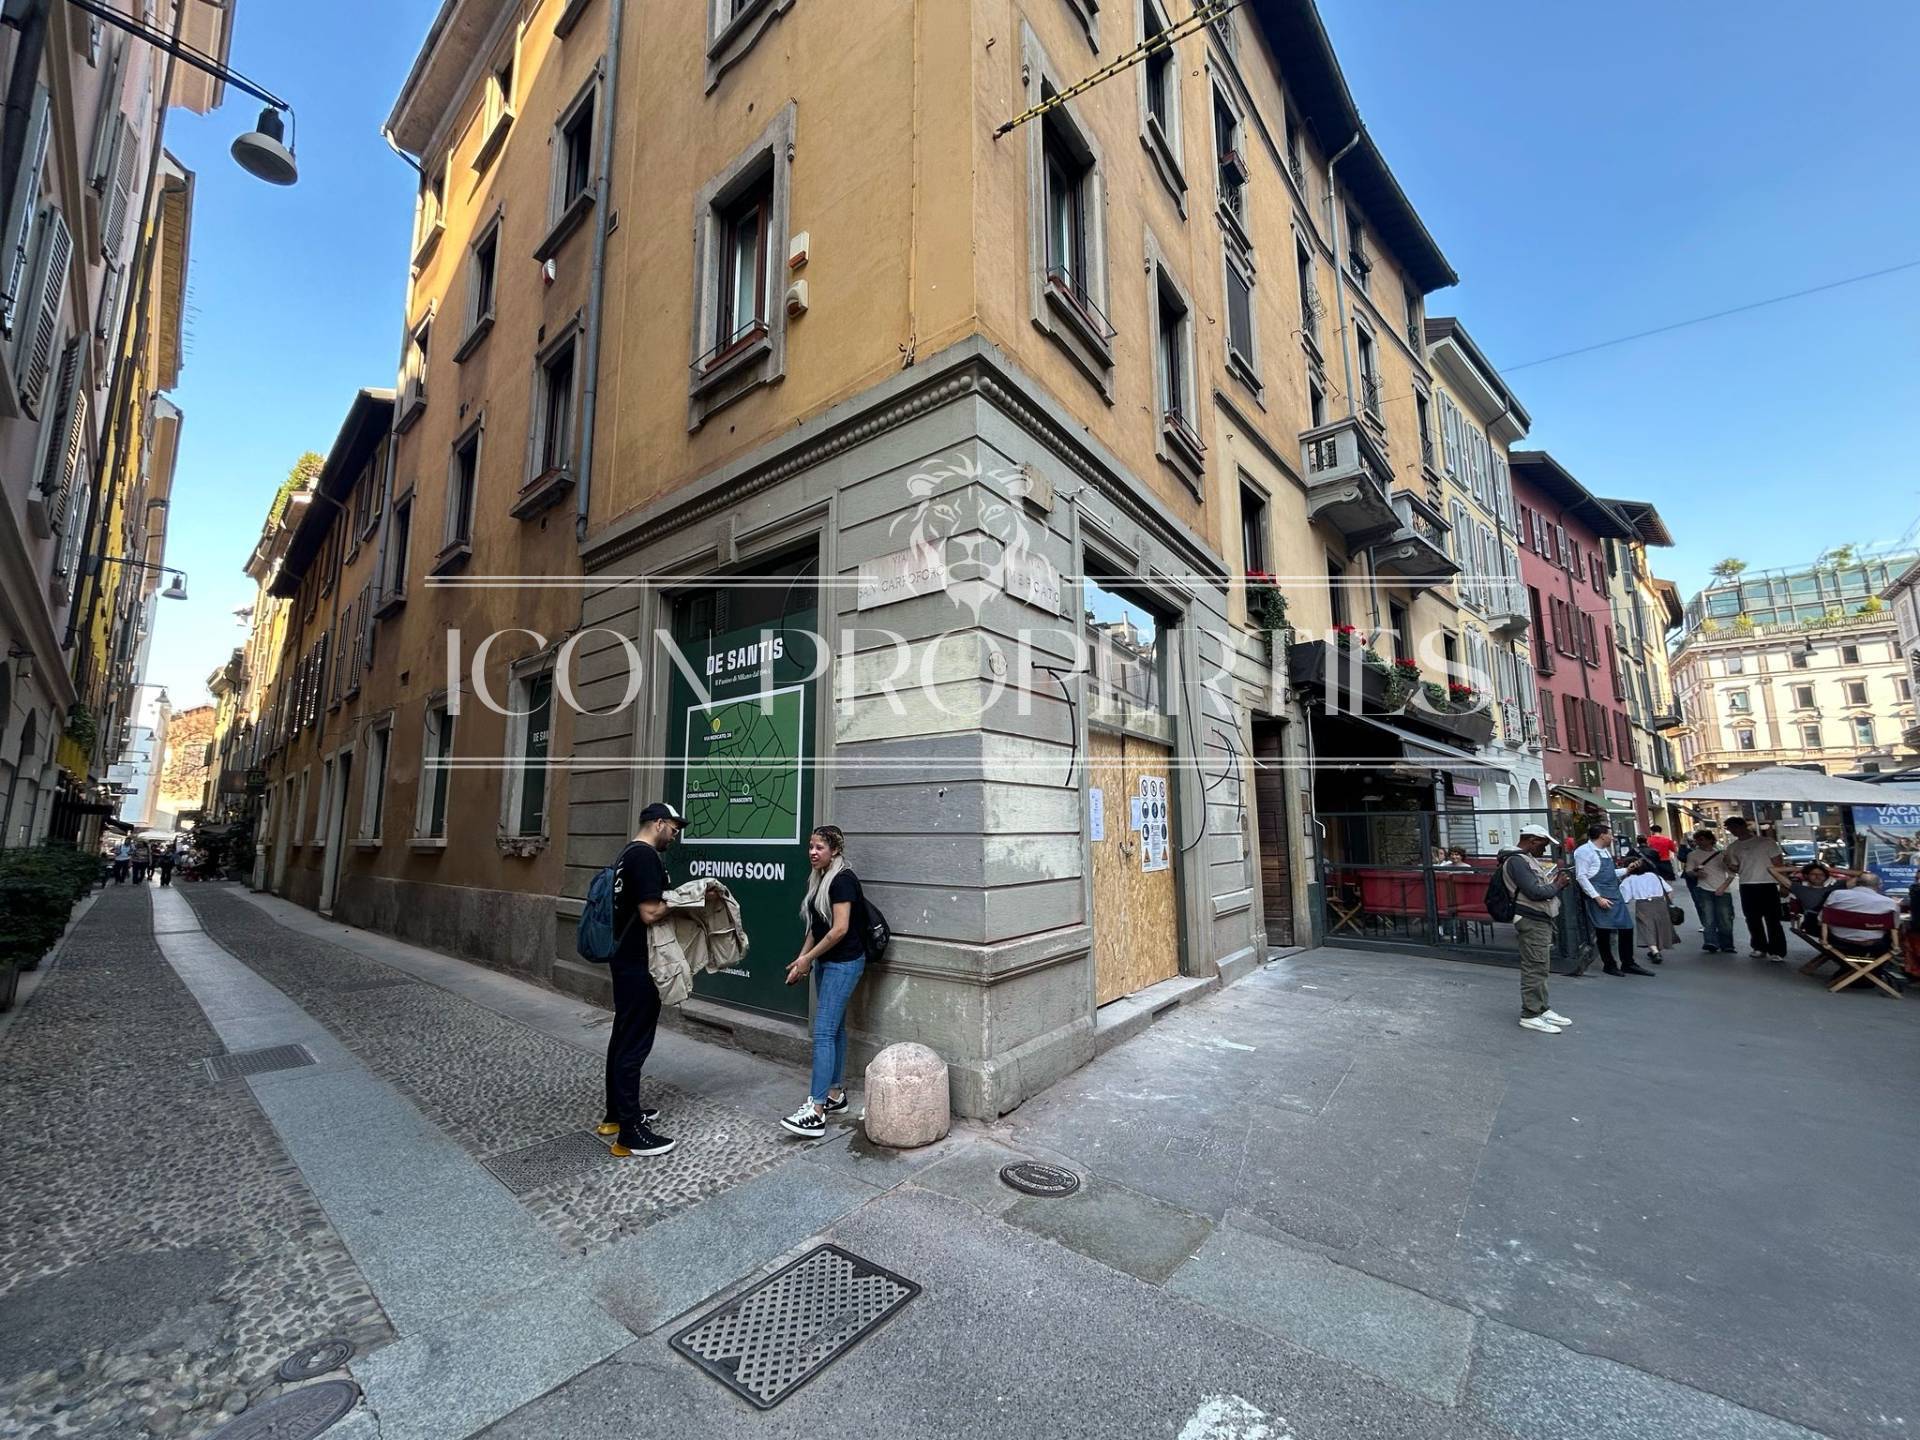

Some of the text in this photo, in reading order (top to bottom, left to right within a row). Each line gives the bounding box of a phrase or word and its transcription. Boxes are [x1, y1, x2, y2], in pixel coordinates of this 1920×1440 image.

[706, 637, 784, 676] DE SANTIS
[1880, 816, 1901, 824] DA
[689, 860, 785, 880] OPENING SOON
